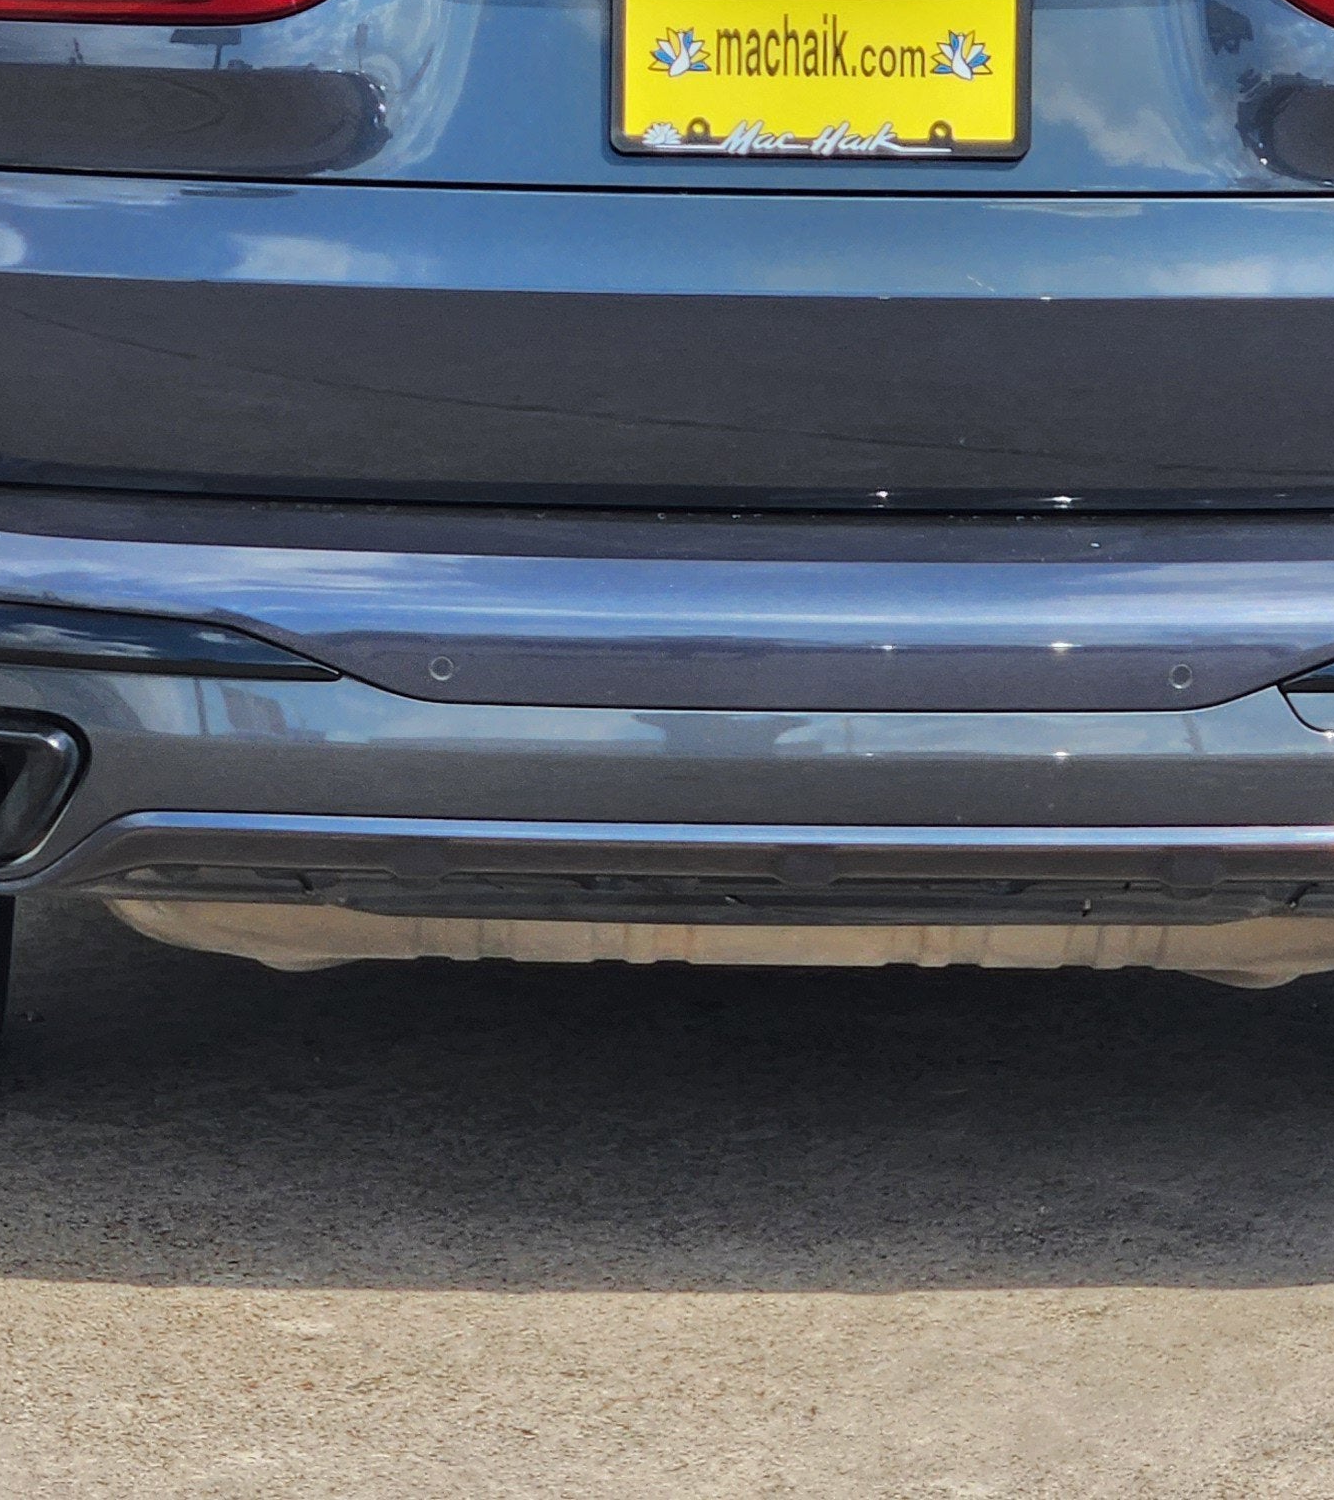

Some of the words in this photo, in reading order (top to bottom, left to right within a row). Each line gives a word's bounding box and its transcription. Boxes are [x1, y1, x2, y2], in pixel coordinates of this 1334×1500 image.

[714, 13, 927, 78] machaik.com
[720, 119, 809, 155] Mac
[811, 119, 903, 156] Haik
